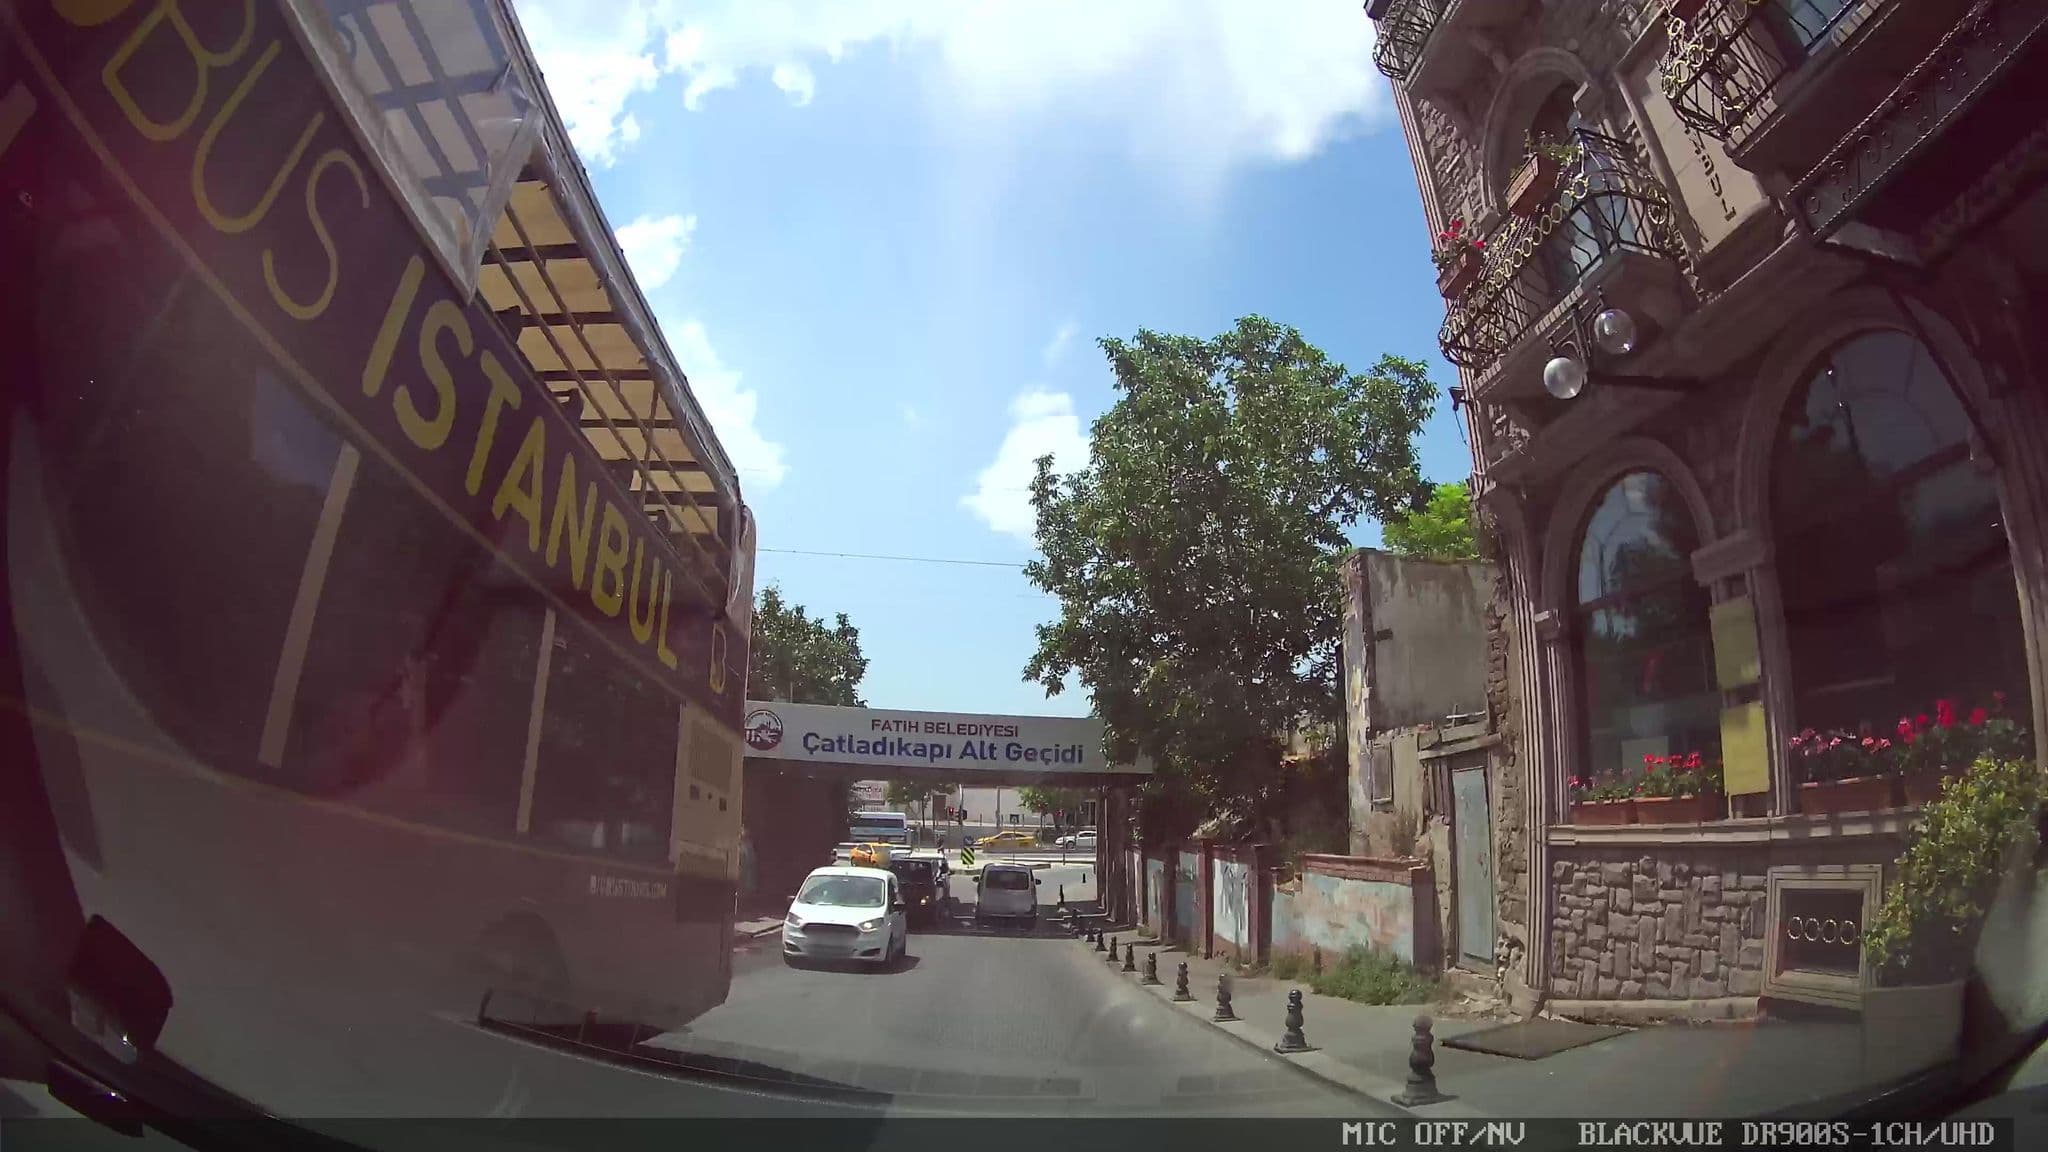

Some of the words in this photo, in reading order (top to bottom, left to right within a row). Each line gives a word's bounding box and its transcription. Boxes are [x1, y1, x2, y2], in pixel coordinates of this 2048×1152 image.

[102, 0, 370, 320] BUS
[361, 254, 679, 672] ISTANBUL
[870, 719, 919, 733] FATİH
[802, 731, 952, 763] Çatladıkapı
[958, 740, 998, 761] Alt
[1004, 741, 1085, 766] Geçidi
